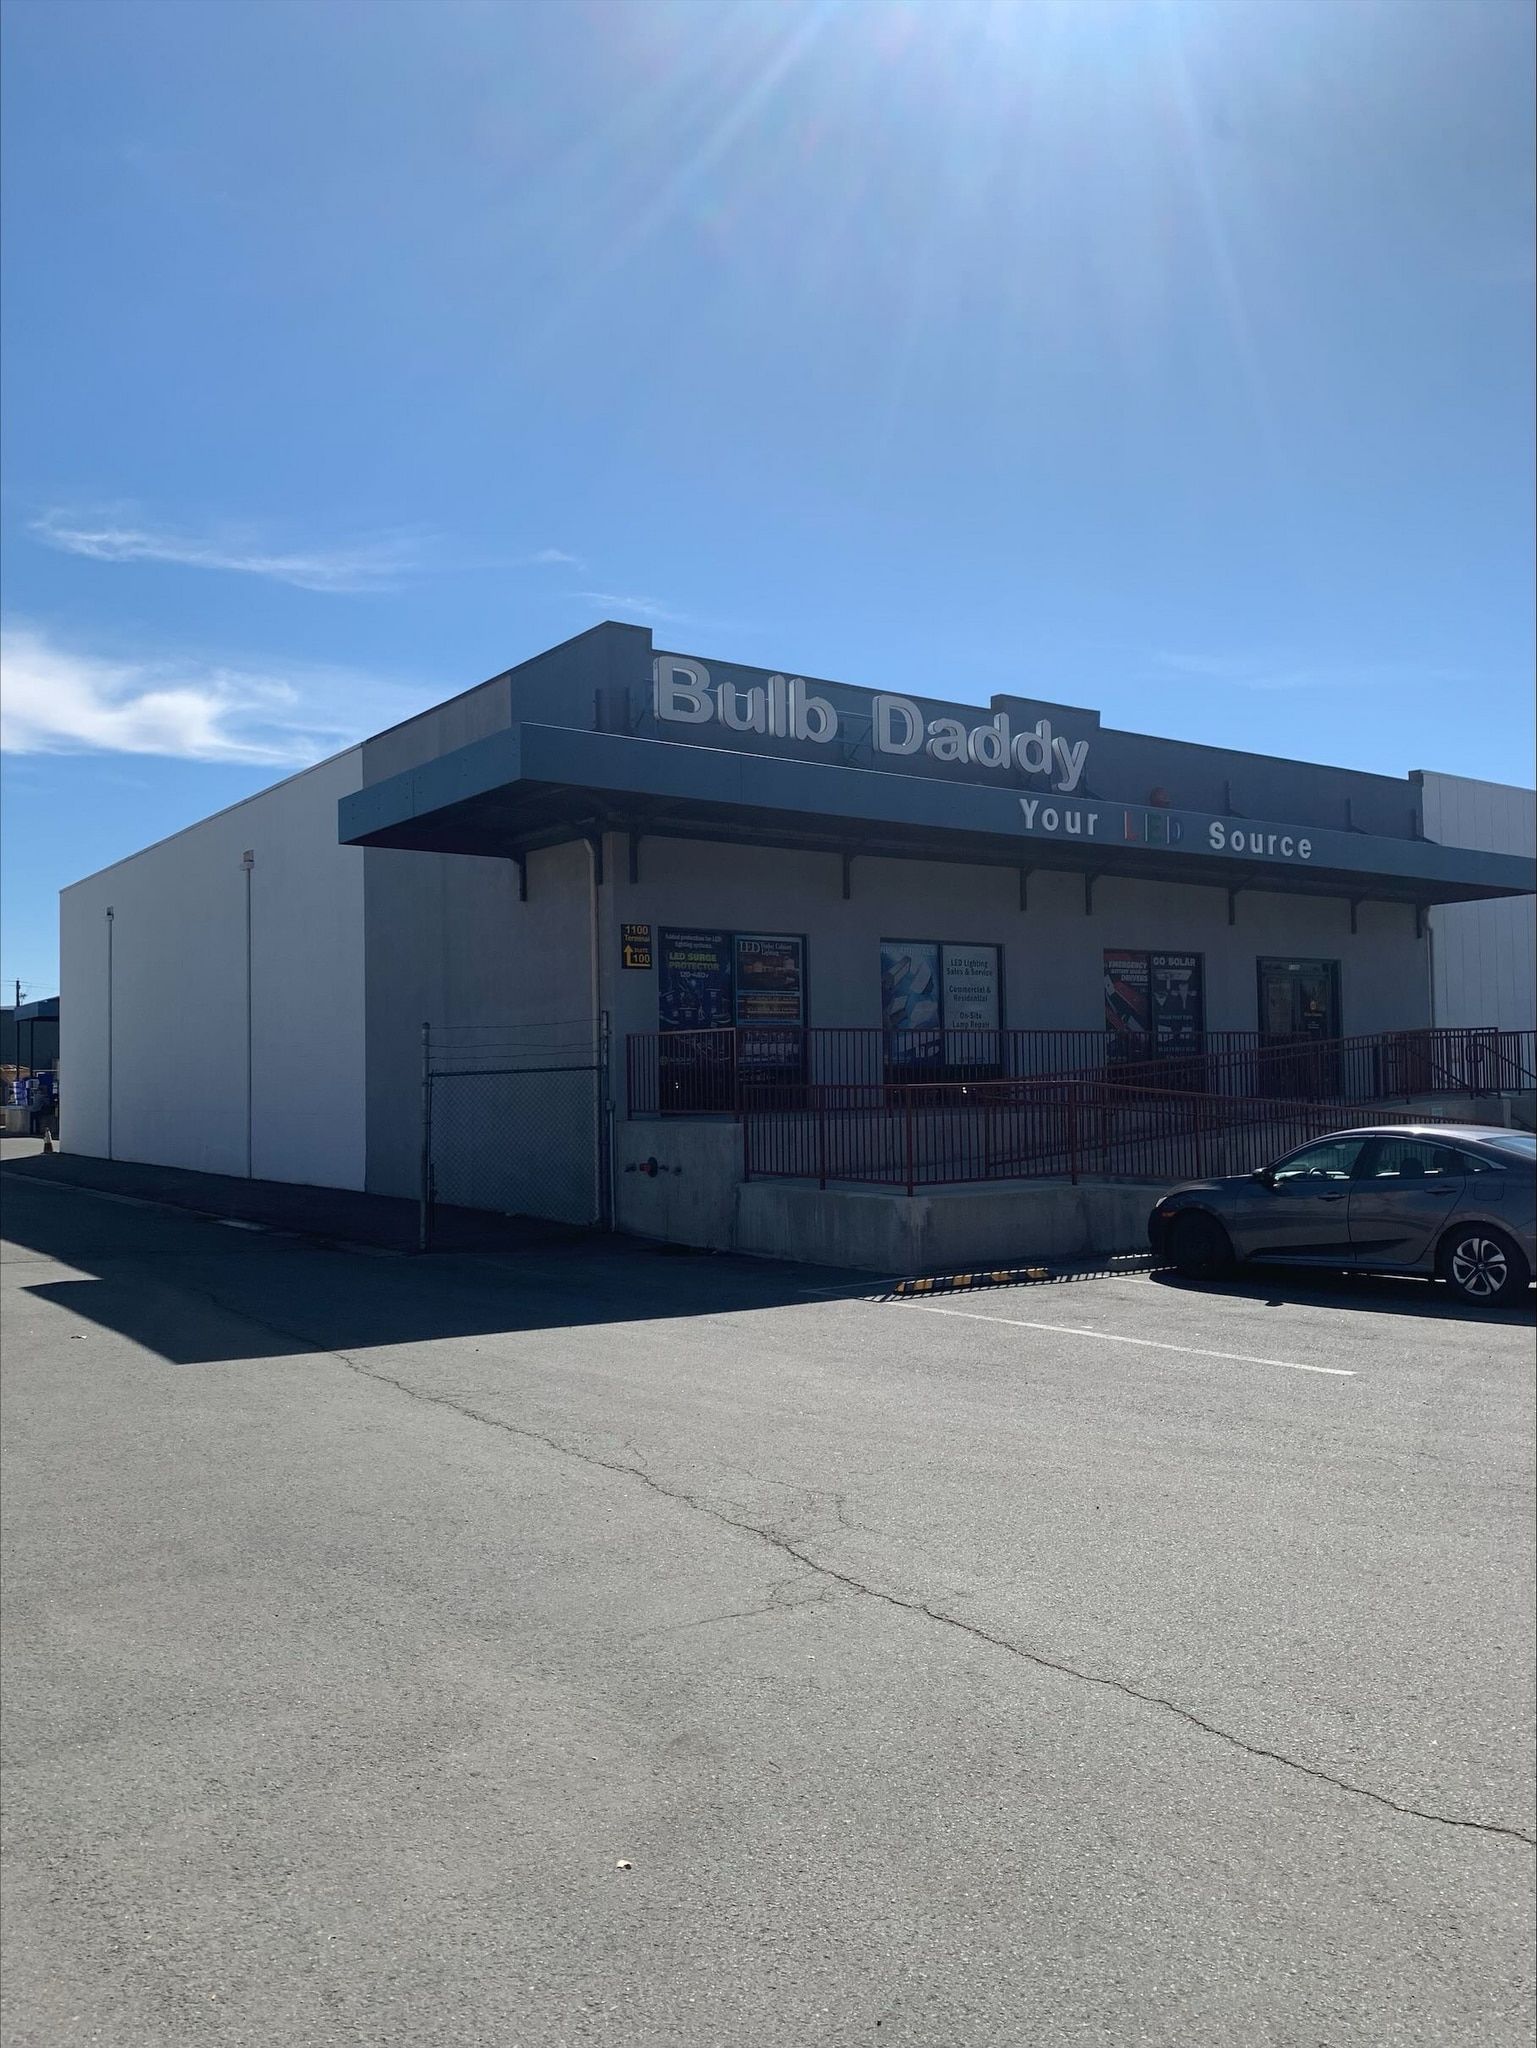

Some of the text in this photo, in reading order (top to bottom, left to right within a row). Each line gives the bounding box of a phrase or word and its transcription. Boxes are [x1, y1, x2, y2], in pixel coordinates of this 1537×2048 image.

[653, 655, 1089, 791] Bulb Daddy
[1018, 798, 1312, 859] Your LED Source
[625, 925, 648, 935] 1100
[623, 934, 651, 942] Terminal
[739, 941, 761, 953] LED
[633, 954, 650, 963] 100
[669, 952, 717, 962] LED SURGE
[1152, 957, 1196, 967] GO SOLAR
[668, 961, 720, 971] PROTECTOR
[950, 959, 988, 969] LED Lighting
[1108, 960, 1148, 969] EMERGENCY
[971, 968, 993, 977] Service
[1120, 974, 1149, 982] DRIVERS
[949, 985, 985, 993] Commercial
[953, 994, 988, 1002] Residential
[952, 1020, 990, 1030] Lamp Repair
